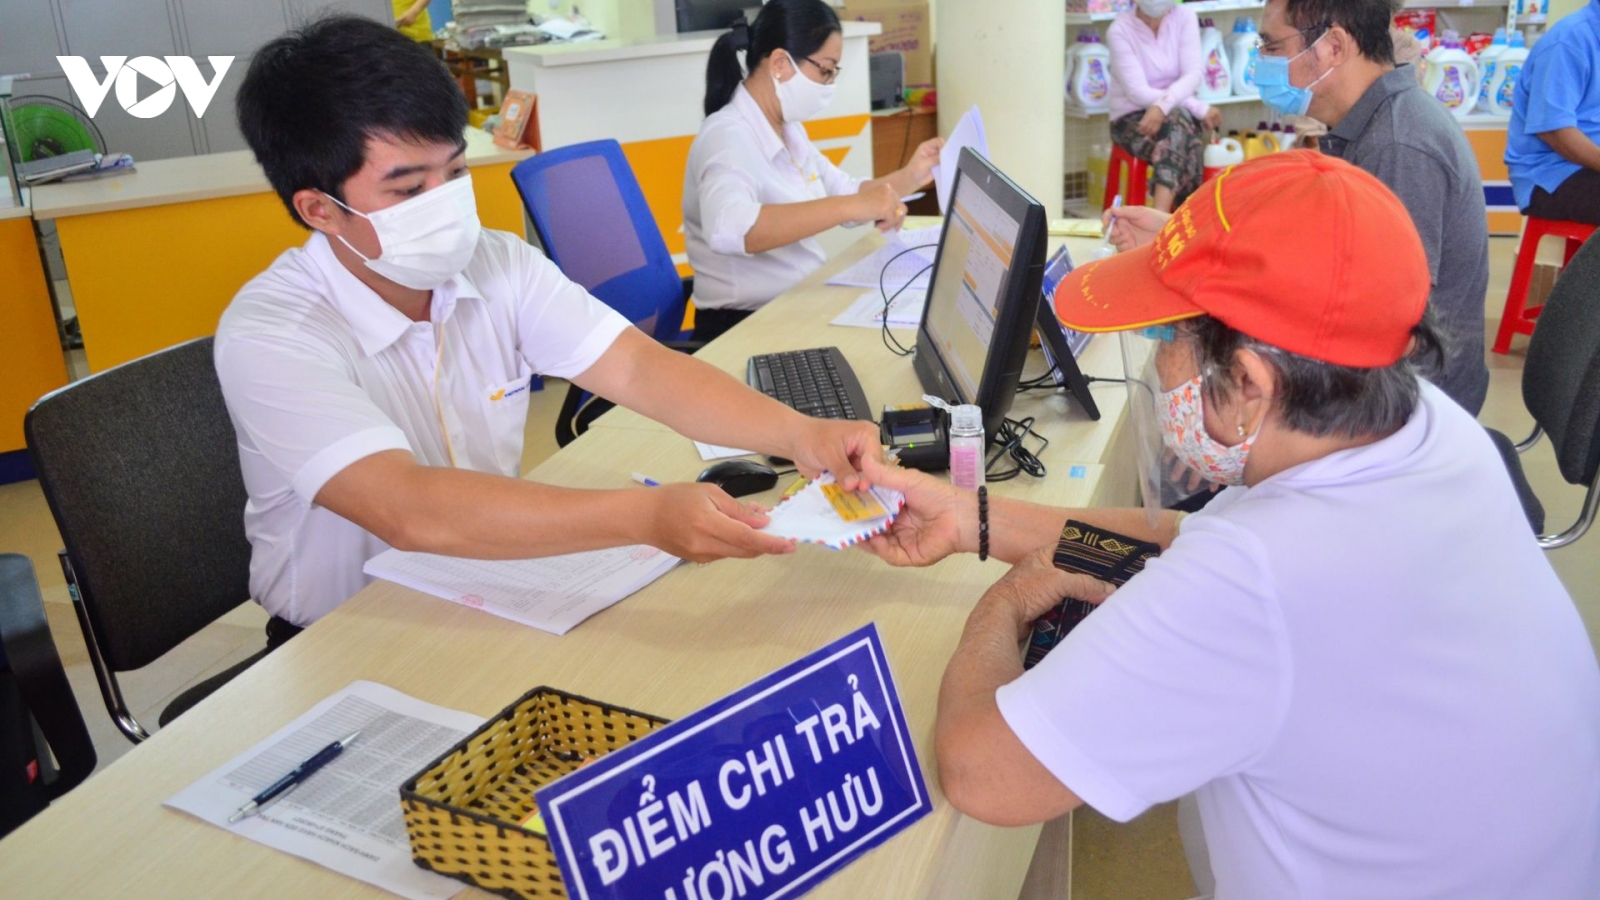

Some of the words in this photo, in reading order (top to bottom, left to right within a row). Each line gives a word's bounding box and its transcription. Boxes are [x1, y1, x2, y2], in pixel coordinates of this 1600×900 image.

[588, 774, 712, 886] ĐIỂM
[718, 734, 795, 811] CHI
[794, 673, 881, 764] TRẢ
[799, 766, 883, 852] HƯU
